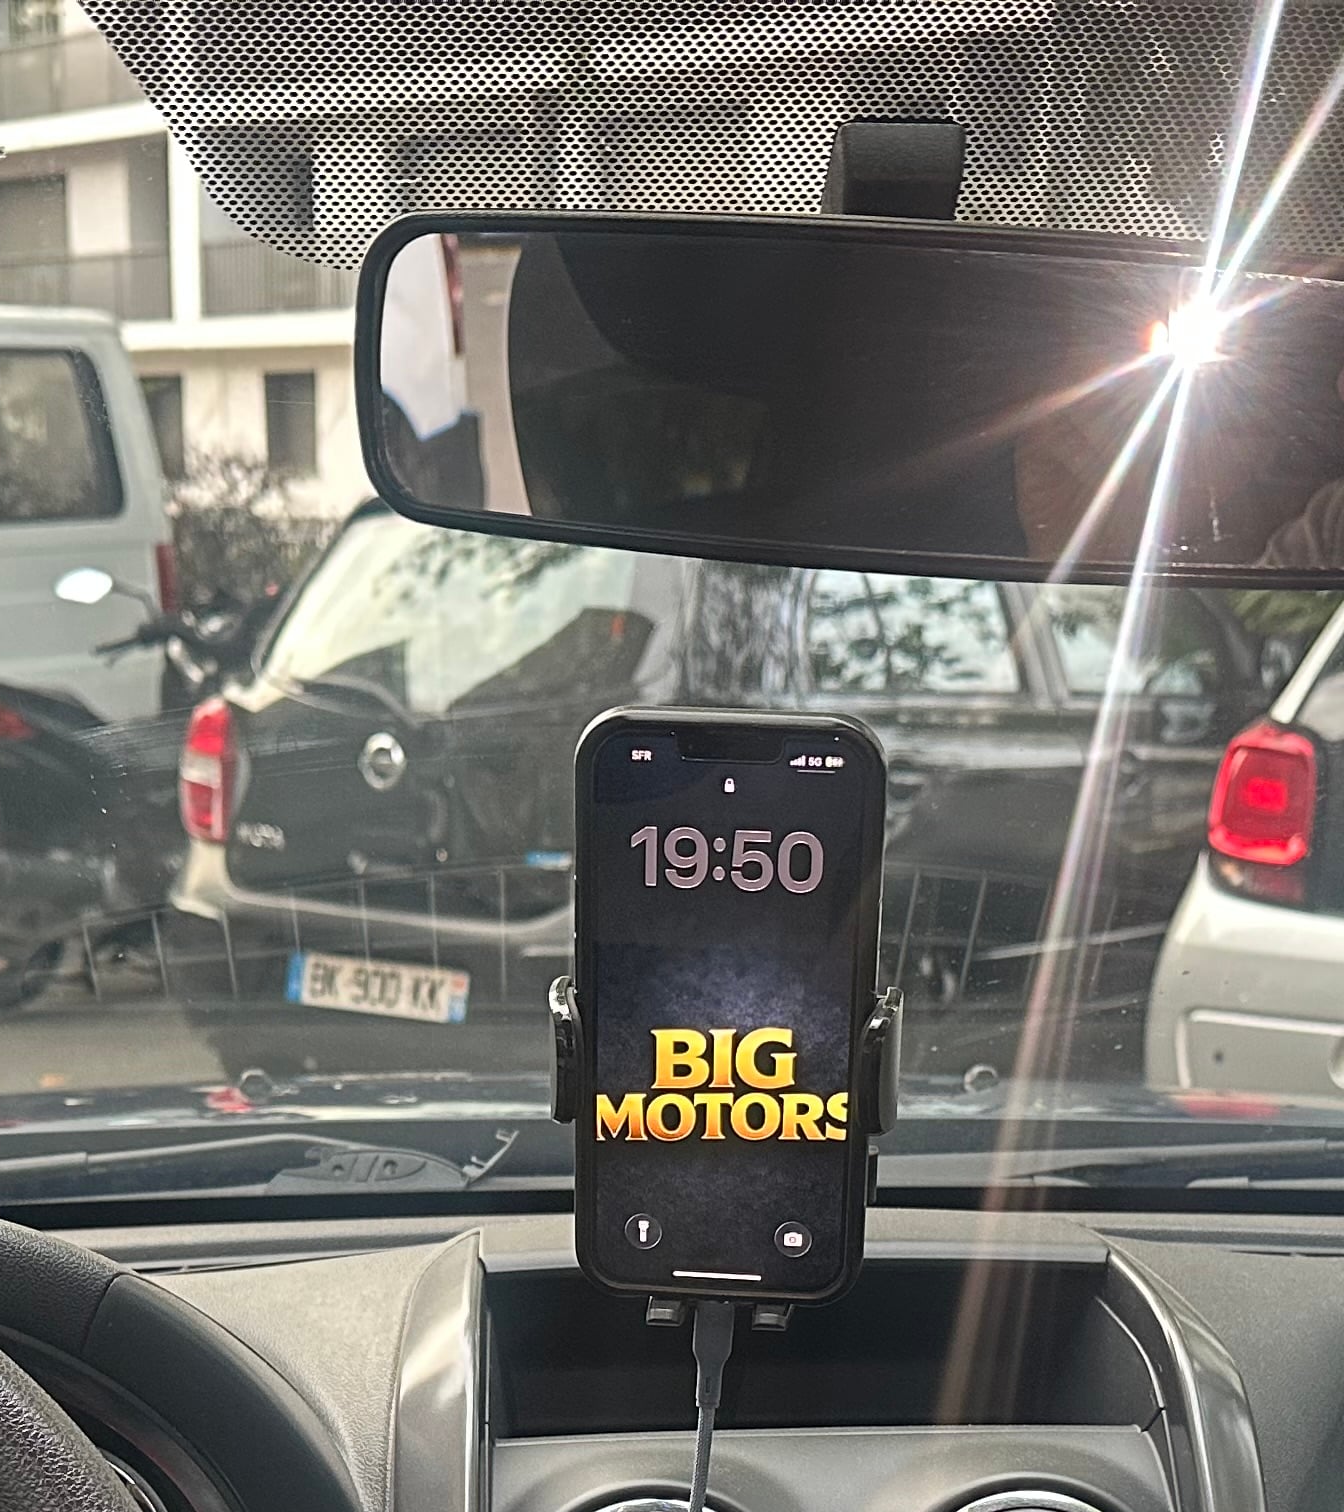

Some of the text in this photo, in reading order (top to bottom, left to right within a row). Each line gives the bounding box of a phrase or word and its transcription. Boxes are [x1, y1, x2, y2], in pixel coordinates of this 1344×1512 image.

[631, 750, 652, 762] SFR
[808, 755, 823, 767] 5G
[630, 825, 824, 894] 19:50
[650, 1027, 796, 1090] BIG
[596, 1091, 849, 1143] MOTORS
